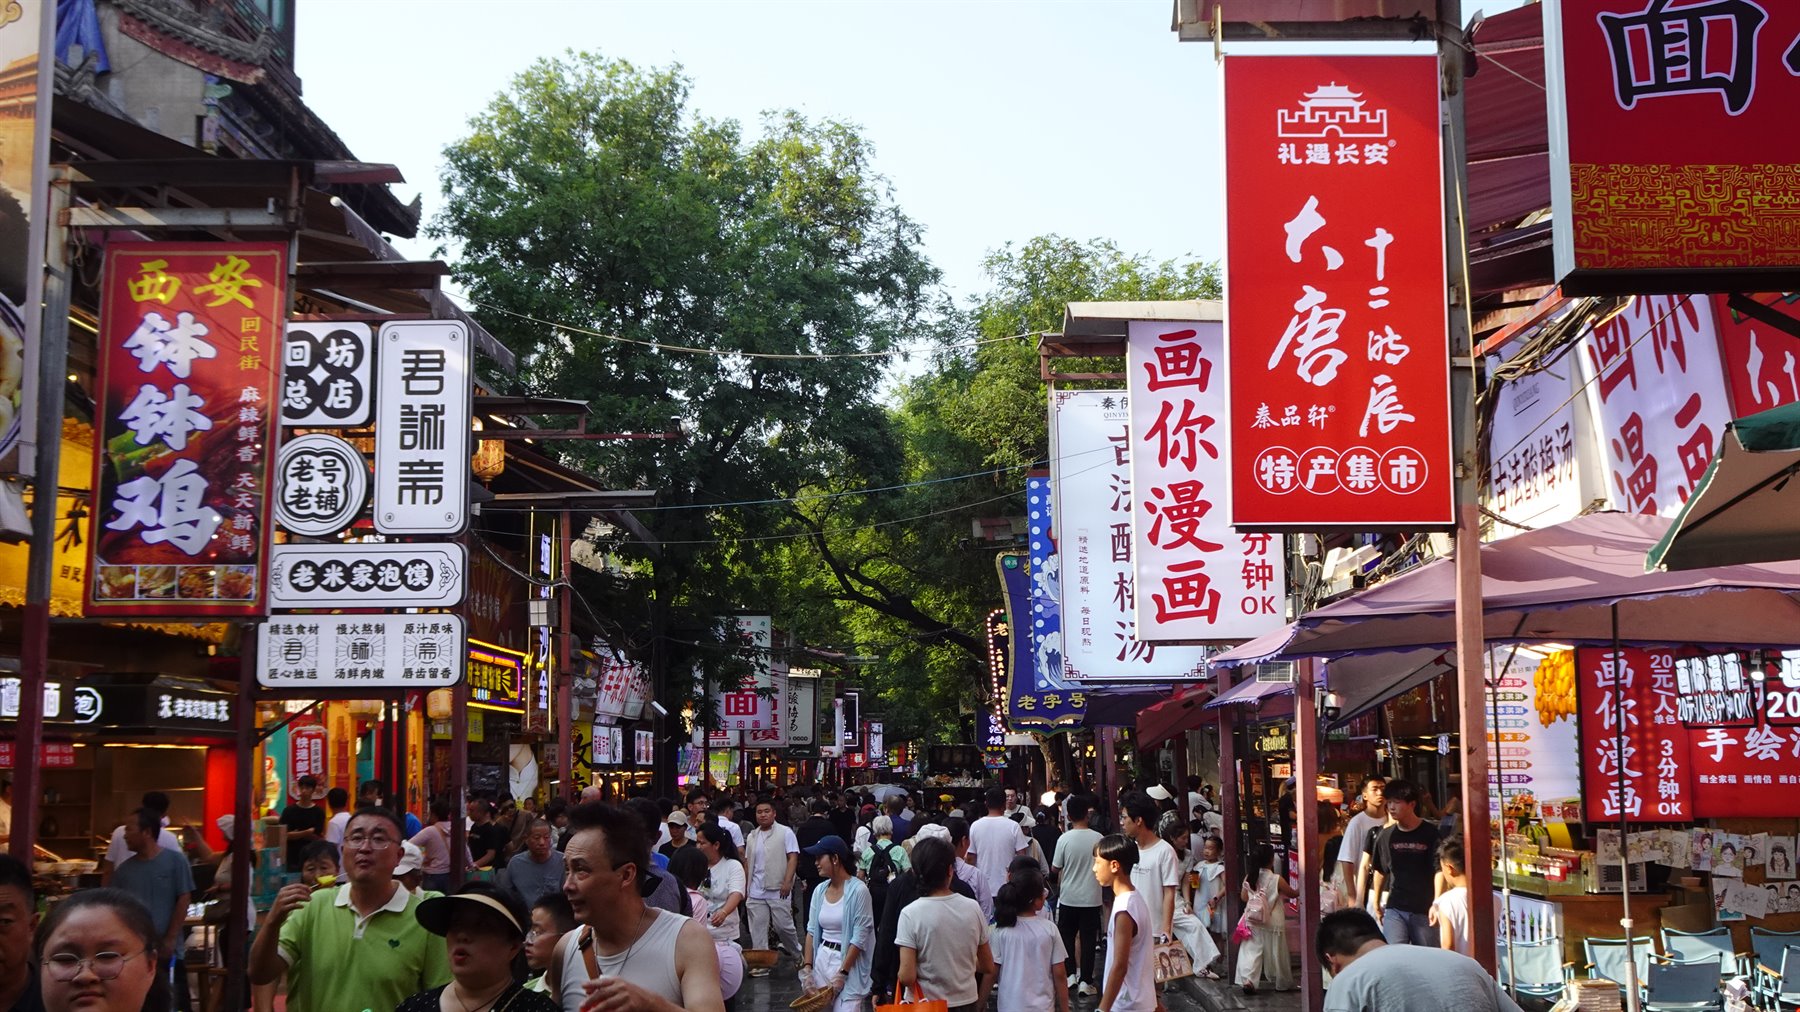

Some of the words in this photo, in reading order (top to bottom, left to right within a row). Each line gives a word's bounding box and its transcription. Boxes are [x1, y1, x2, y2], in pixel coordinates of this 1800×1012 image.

[1277, 143, 1389, 165] 礼遇长安
[127, 255, 263, 309] 西安
[1267, 195, 1348, 386] 大唐
[239, 316, 262, 370] 回民街
[1359, 227, 1415, 437] 十二时辰
[1250, 402, 1329, 430] 秦品轩
[105, 312, 223, 556] 钵钵鸡
[289, 457, 341, 483] 老号
[1143, 329, 1224, 625] 画你漫画
[1260, 454, 1418, 489] 特产集市
[287, 486, 340, 512] 老铺
[291, 563, 430, 588] 老米家泡馍
[269, 624, 319, 635] 精选食材
[336, 624, 385, 635] 慢火熬制
[404, 624, 453, 635] 原汁原味
[268, 669, 318, 680] 匠心独运
[335, 669, 384, 680] 汤鲜肉嫩
[402, 668, 452, 679] 唇齿留香
[1017, 692, 1086, 711] 老字号
[1594, 651, 1643, 817] 画你漫画
[1697, 723, 1800, 763] 手绘
